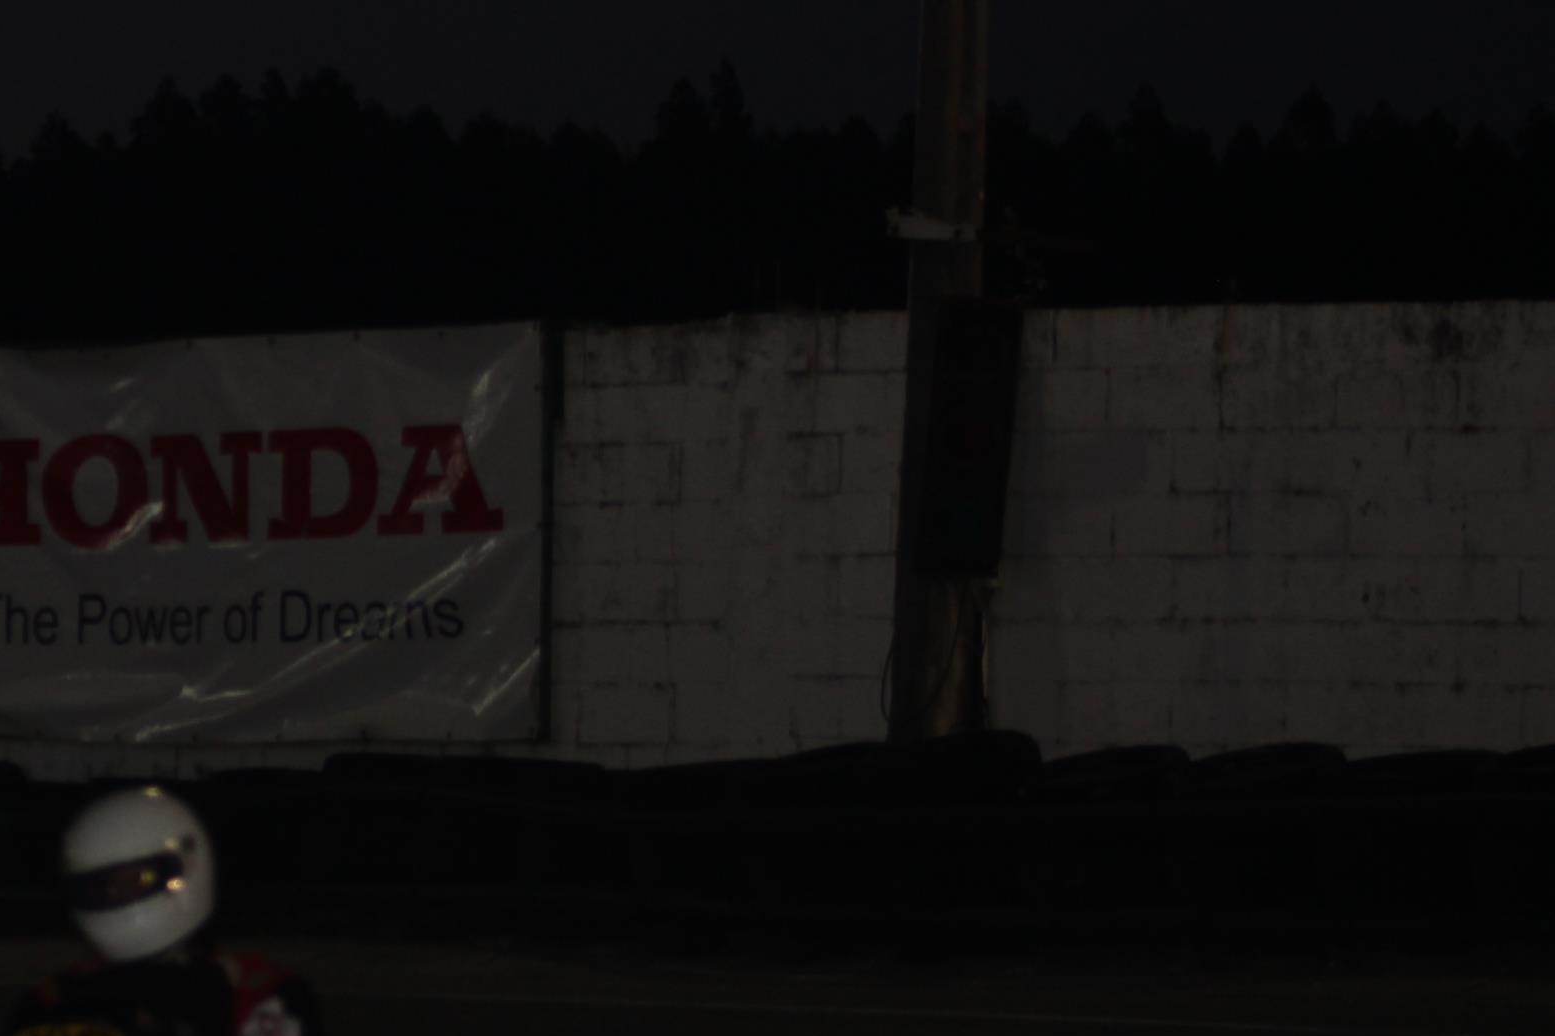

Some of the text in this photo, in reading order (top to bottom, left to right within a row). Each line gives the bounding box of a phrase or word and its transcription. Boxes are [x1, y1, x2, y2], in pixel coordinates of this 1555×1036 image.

[77, 593, 209, 645] Power
[224, 590, 264, 643] of
[279, 590, 464, 643] Dreams
